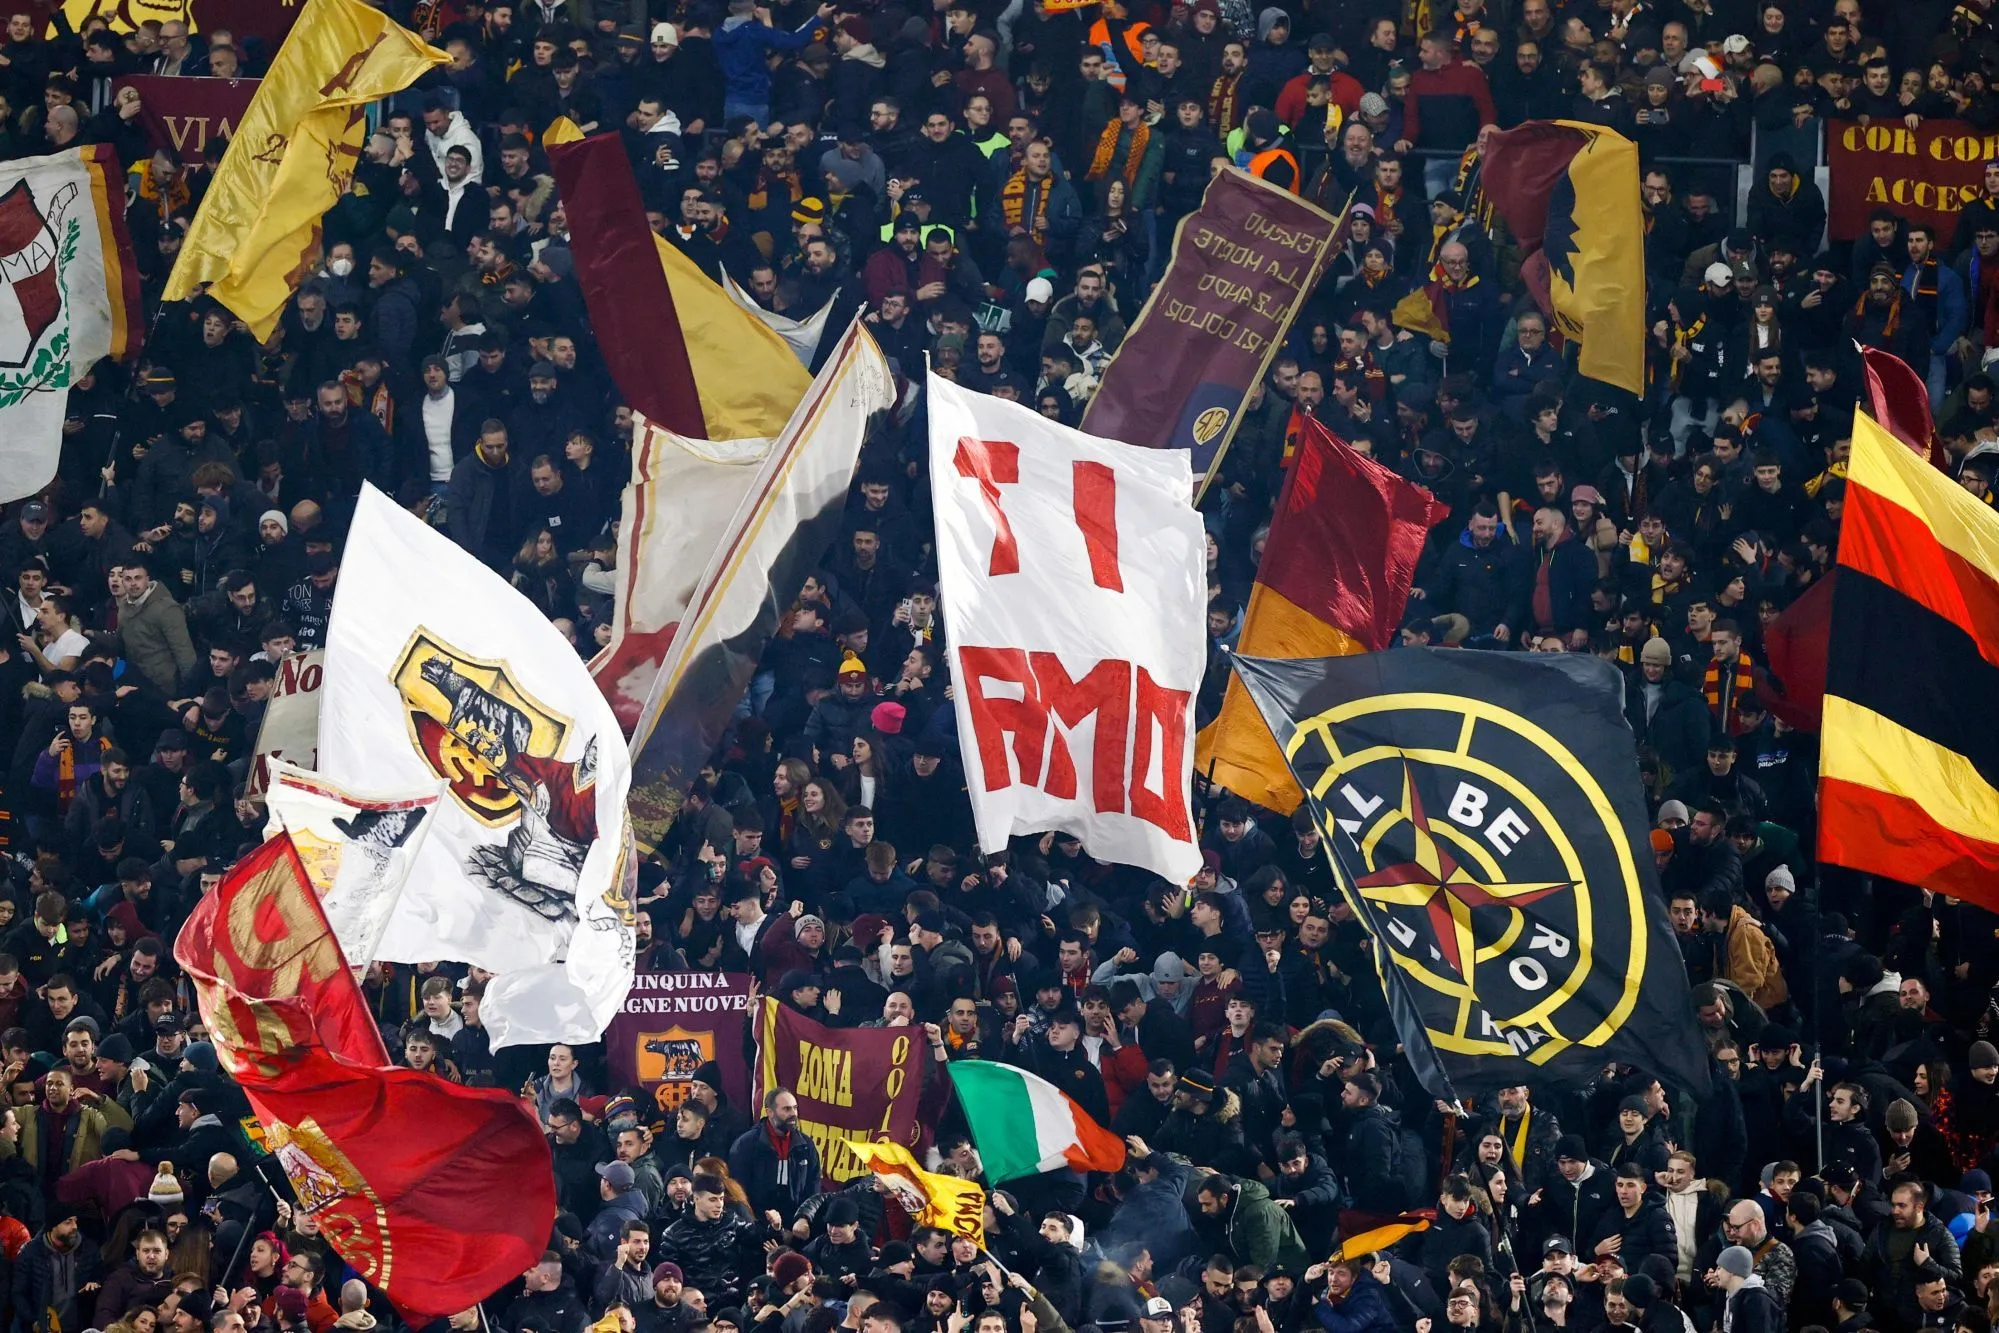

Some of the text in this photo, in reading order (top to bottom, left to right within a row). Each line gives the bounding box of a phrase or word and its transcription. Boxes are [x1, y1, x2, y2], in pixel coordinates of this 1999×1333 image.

[0, 241, 51, 285] MA
[630, 972, 730, 992] INQUINA
[674, 994, 747, 1013] NUOVE
[796, 1040, 853, 1108] ZONA
